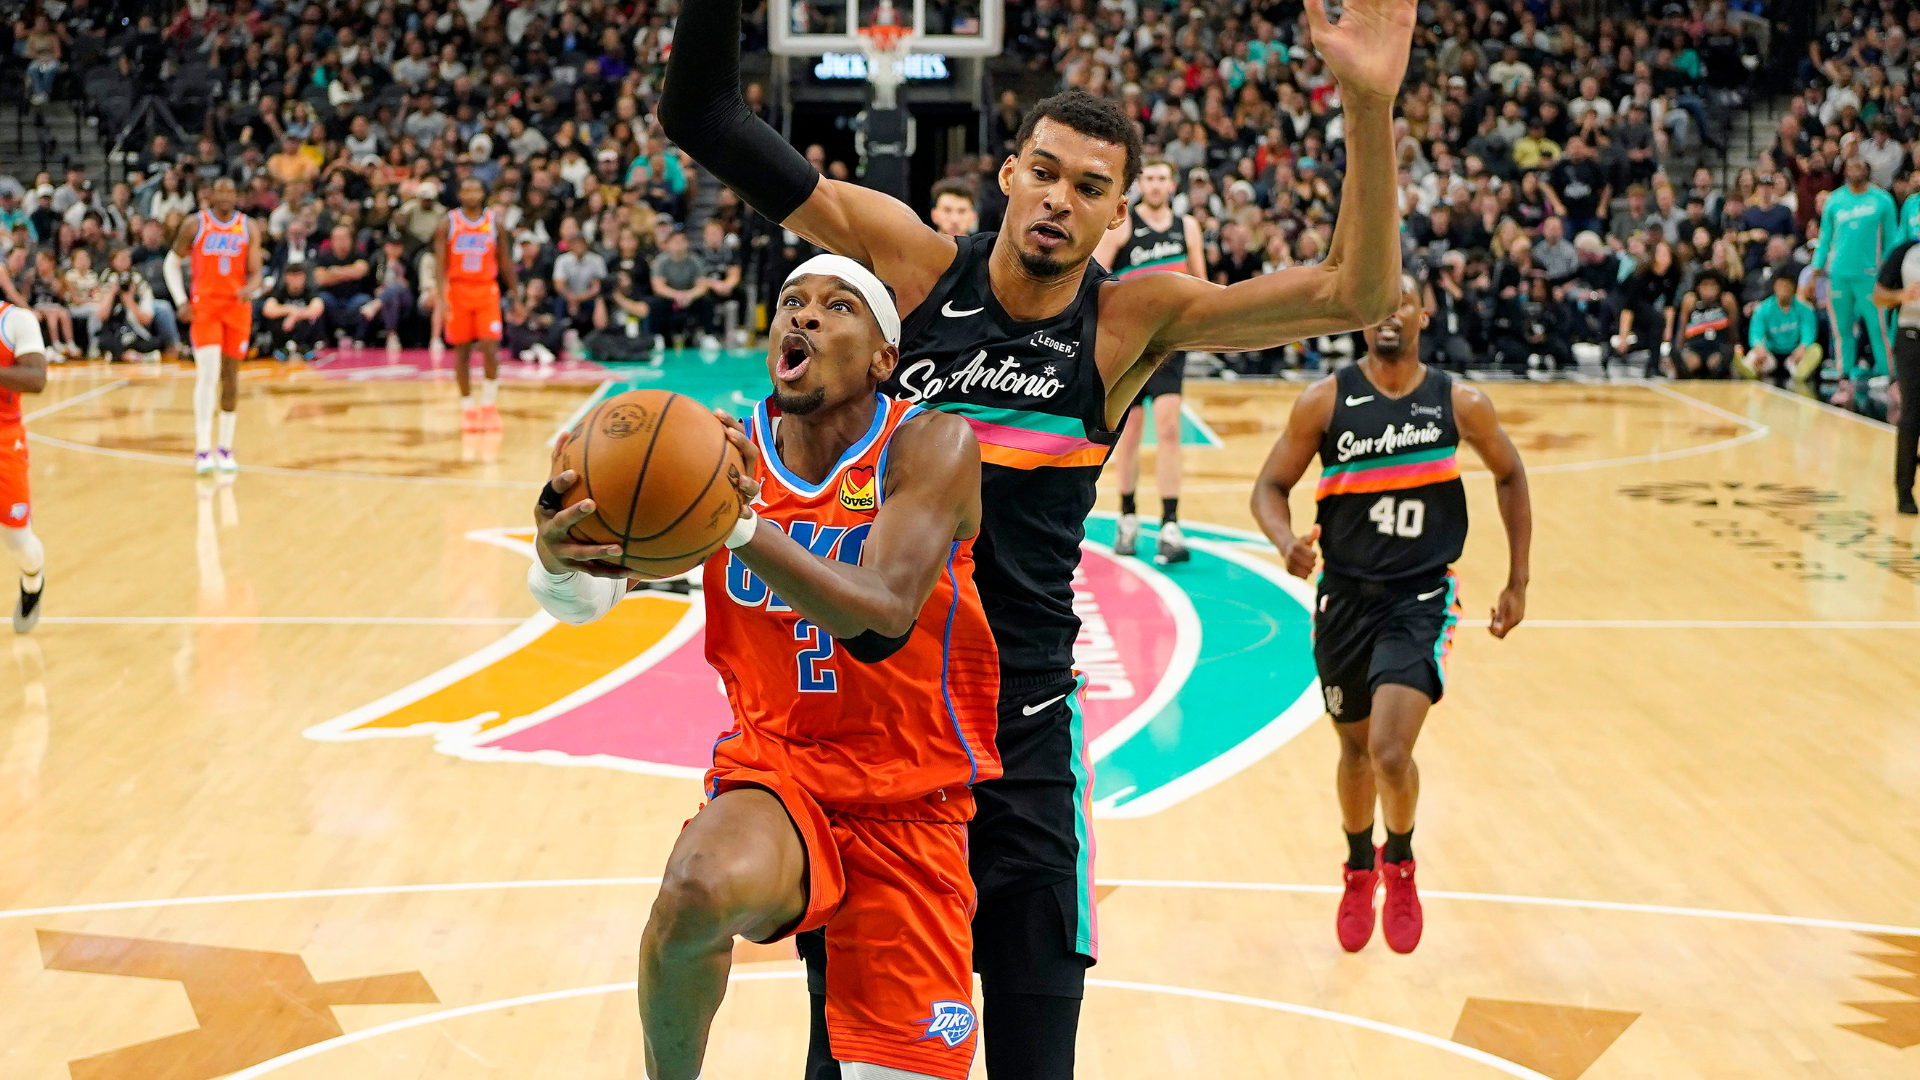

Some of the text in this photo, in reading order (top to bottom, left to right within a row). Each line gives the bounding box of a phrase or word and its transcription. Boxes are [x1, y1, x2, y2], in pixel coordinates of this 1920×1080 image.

[1037, 333, 1073, 355] LEDGER
[895, 349, 1065, 403] Sa Antonio
[1336, 420, 1443, 463] San Antonio
[1368, 495, 1425, 538] 40
[794, 617, 837, 693] 2
[928, 1012, 970, 1033] OKC
